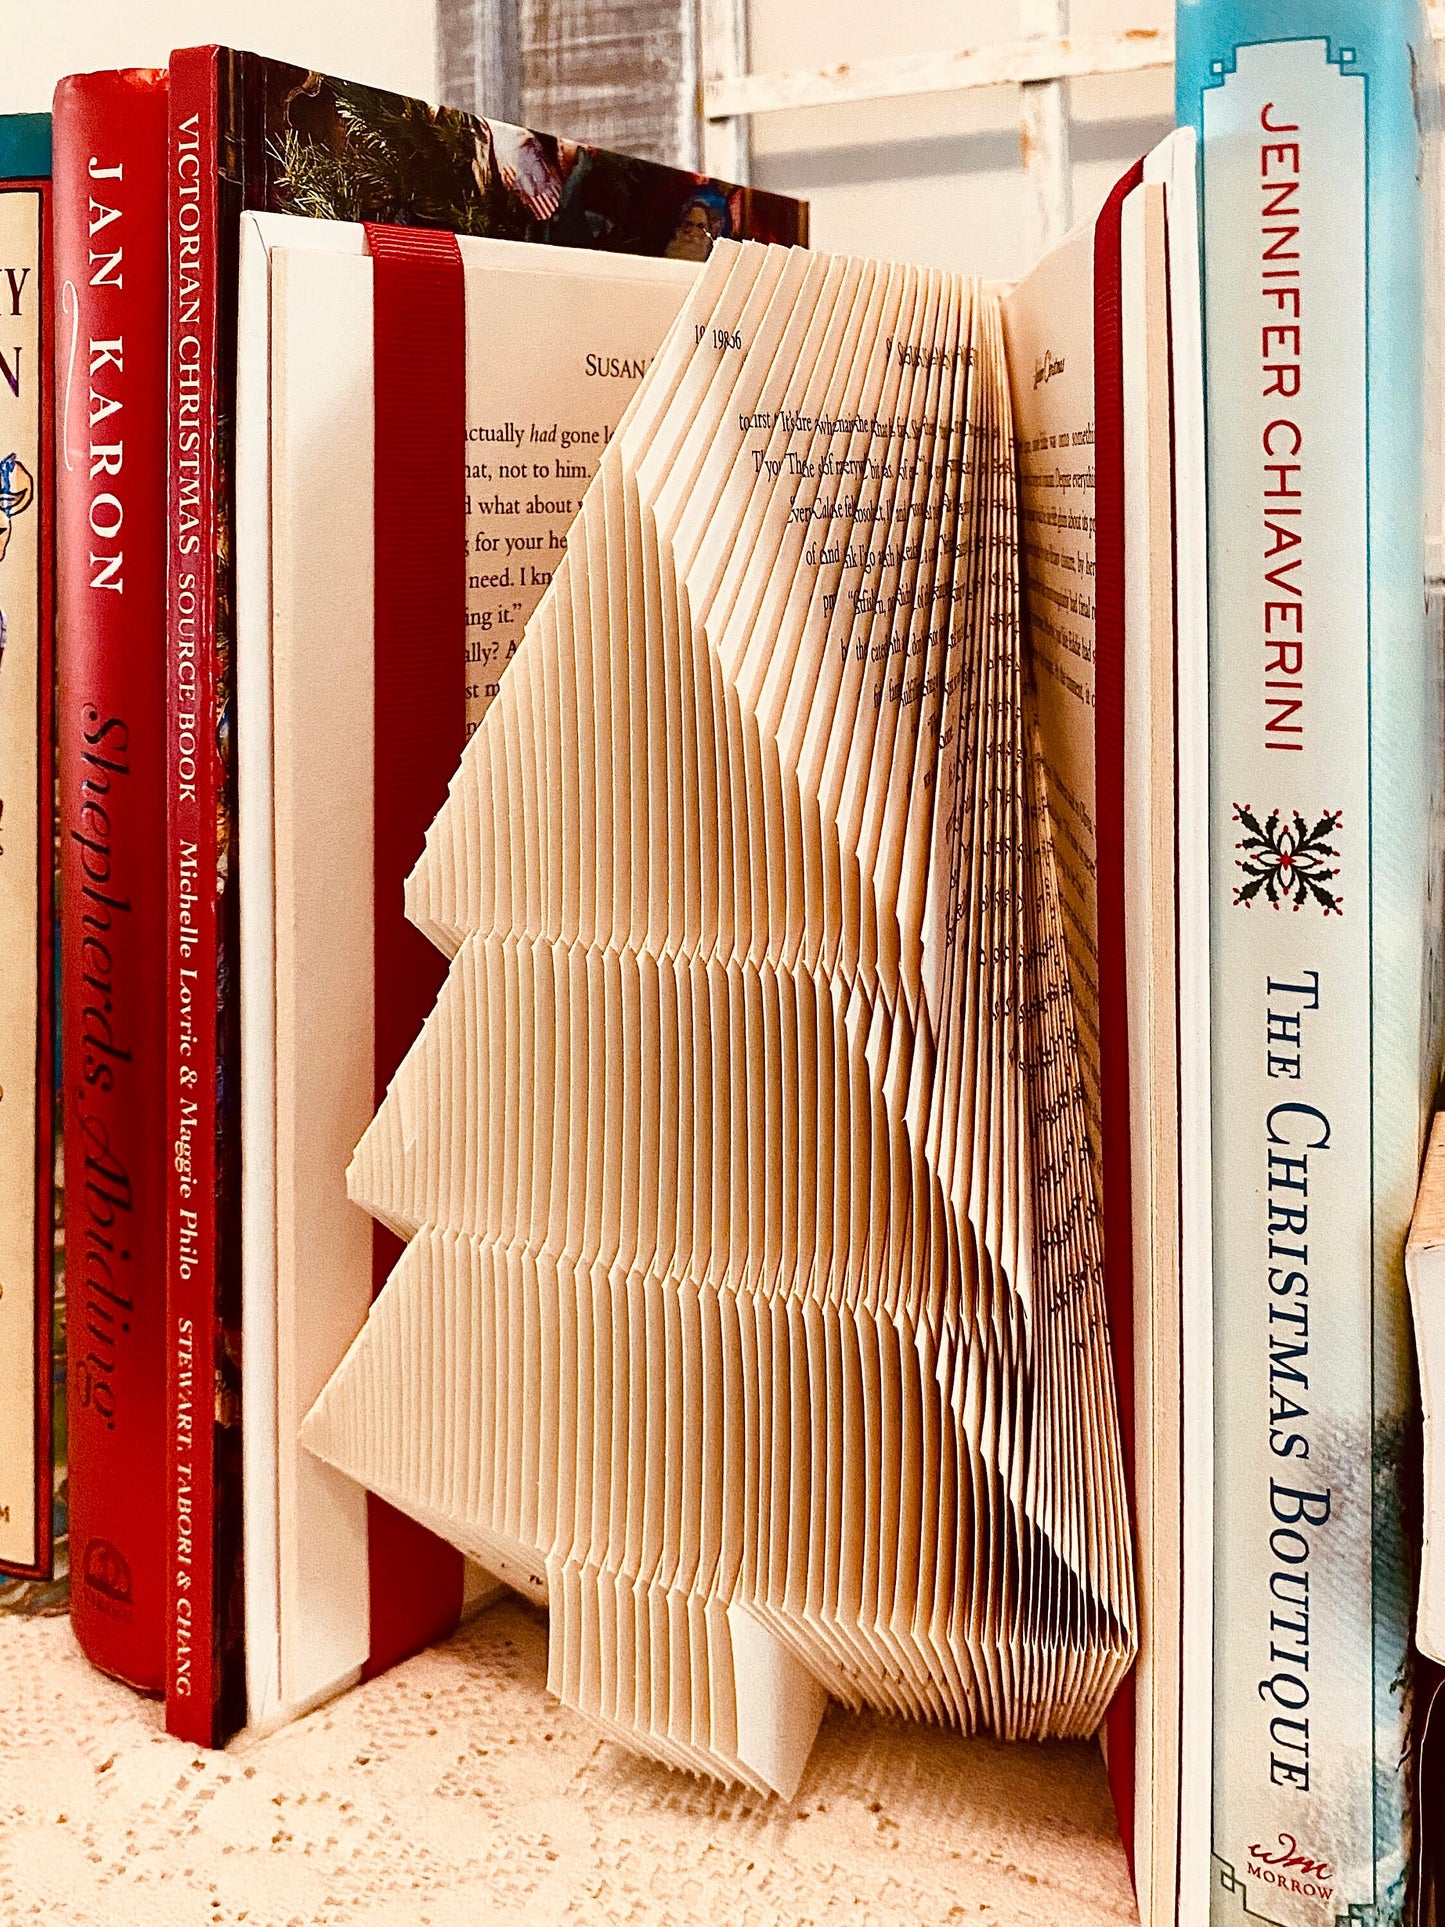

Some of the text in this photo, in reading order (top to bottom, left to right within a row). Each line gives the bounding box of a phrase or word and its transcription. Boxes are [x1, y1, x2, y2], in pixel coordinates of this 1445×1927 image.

[88, 157, 124, 595] JAN KARON
[585, 353, 646, 378] SUSAN
[177, 112, 201, 803] VICTORIAN CHRISTMAS SOURCE BOOK
[530, 423, 557, 443] had
[561, 430, 600, 449] gone
[1260, 103, 1304, 752] JENNIFER CHIAVERINI
[499, 464, 528, 479] not
[533, 463, 550, 479] to
[555, 459, 591, 479] him.
[479, 495, 521, 514] what
[526, 495, 573, 514] about
[469, 567, 514, 589] need.
[475, 531, 500, 551] for
[505, 536, 544, 556] your
[70, 702, 132, 1092] Shepherds
[174, 839, 199, 1280] Michelle Lovric & Maggie Philo
[1258, 970, 1332, 1792] THE CHRISTMAS BOUTIQUE
[176, 1462, 193, 1566] TABORI
[175, 1570, 192, 1591] &
[175, 1597, 193, 1698] CHANG
[1246, 1861, 1334, 1900] MORROW
